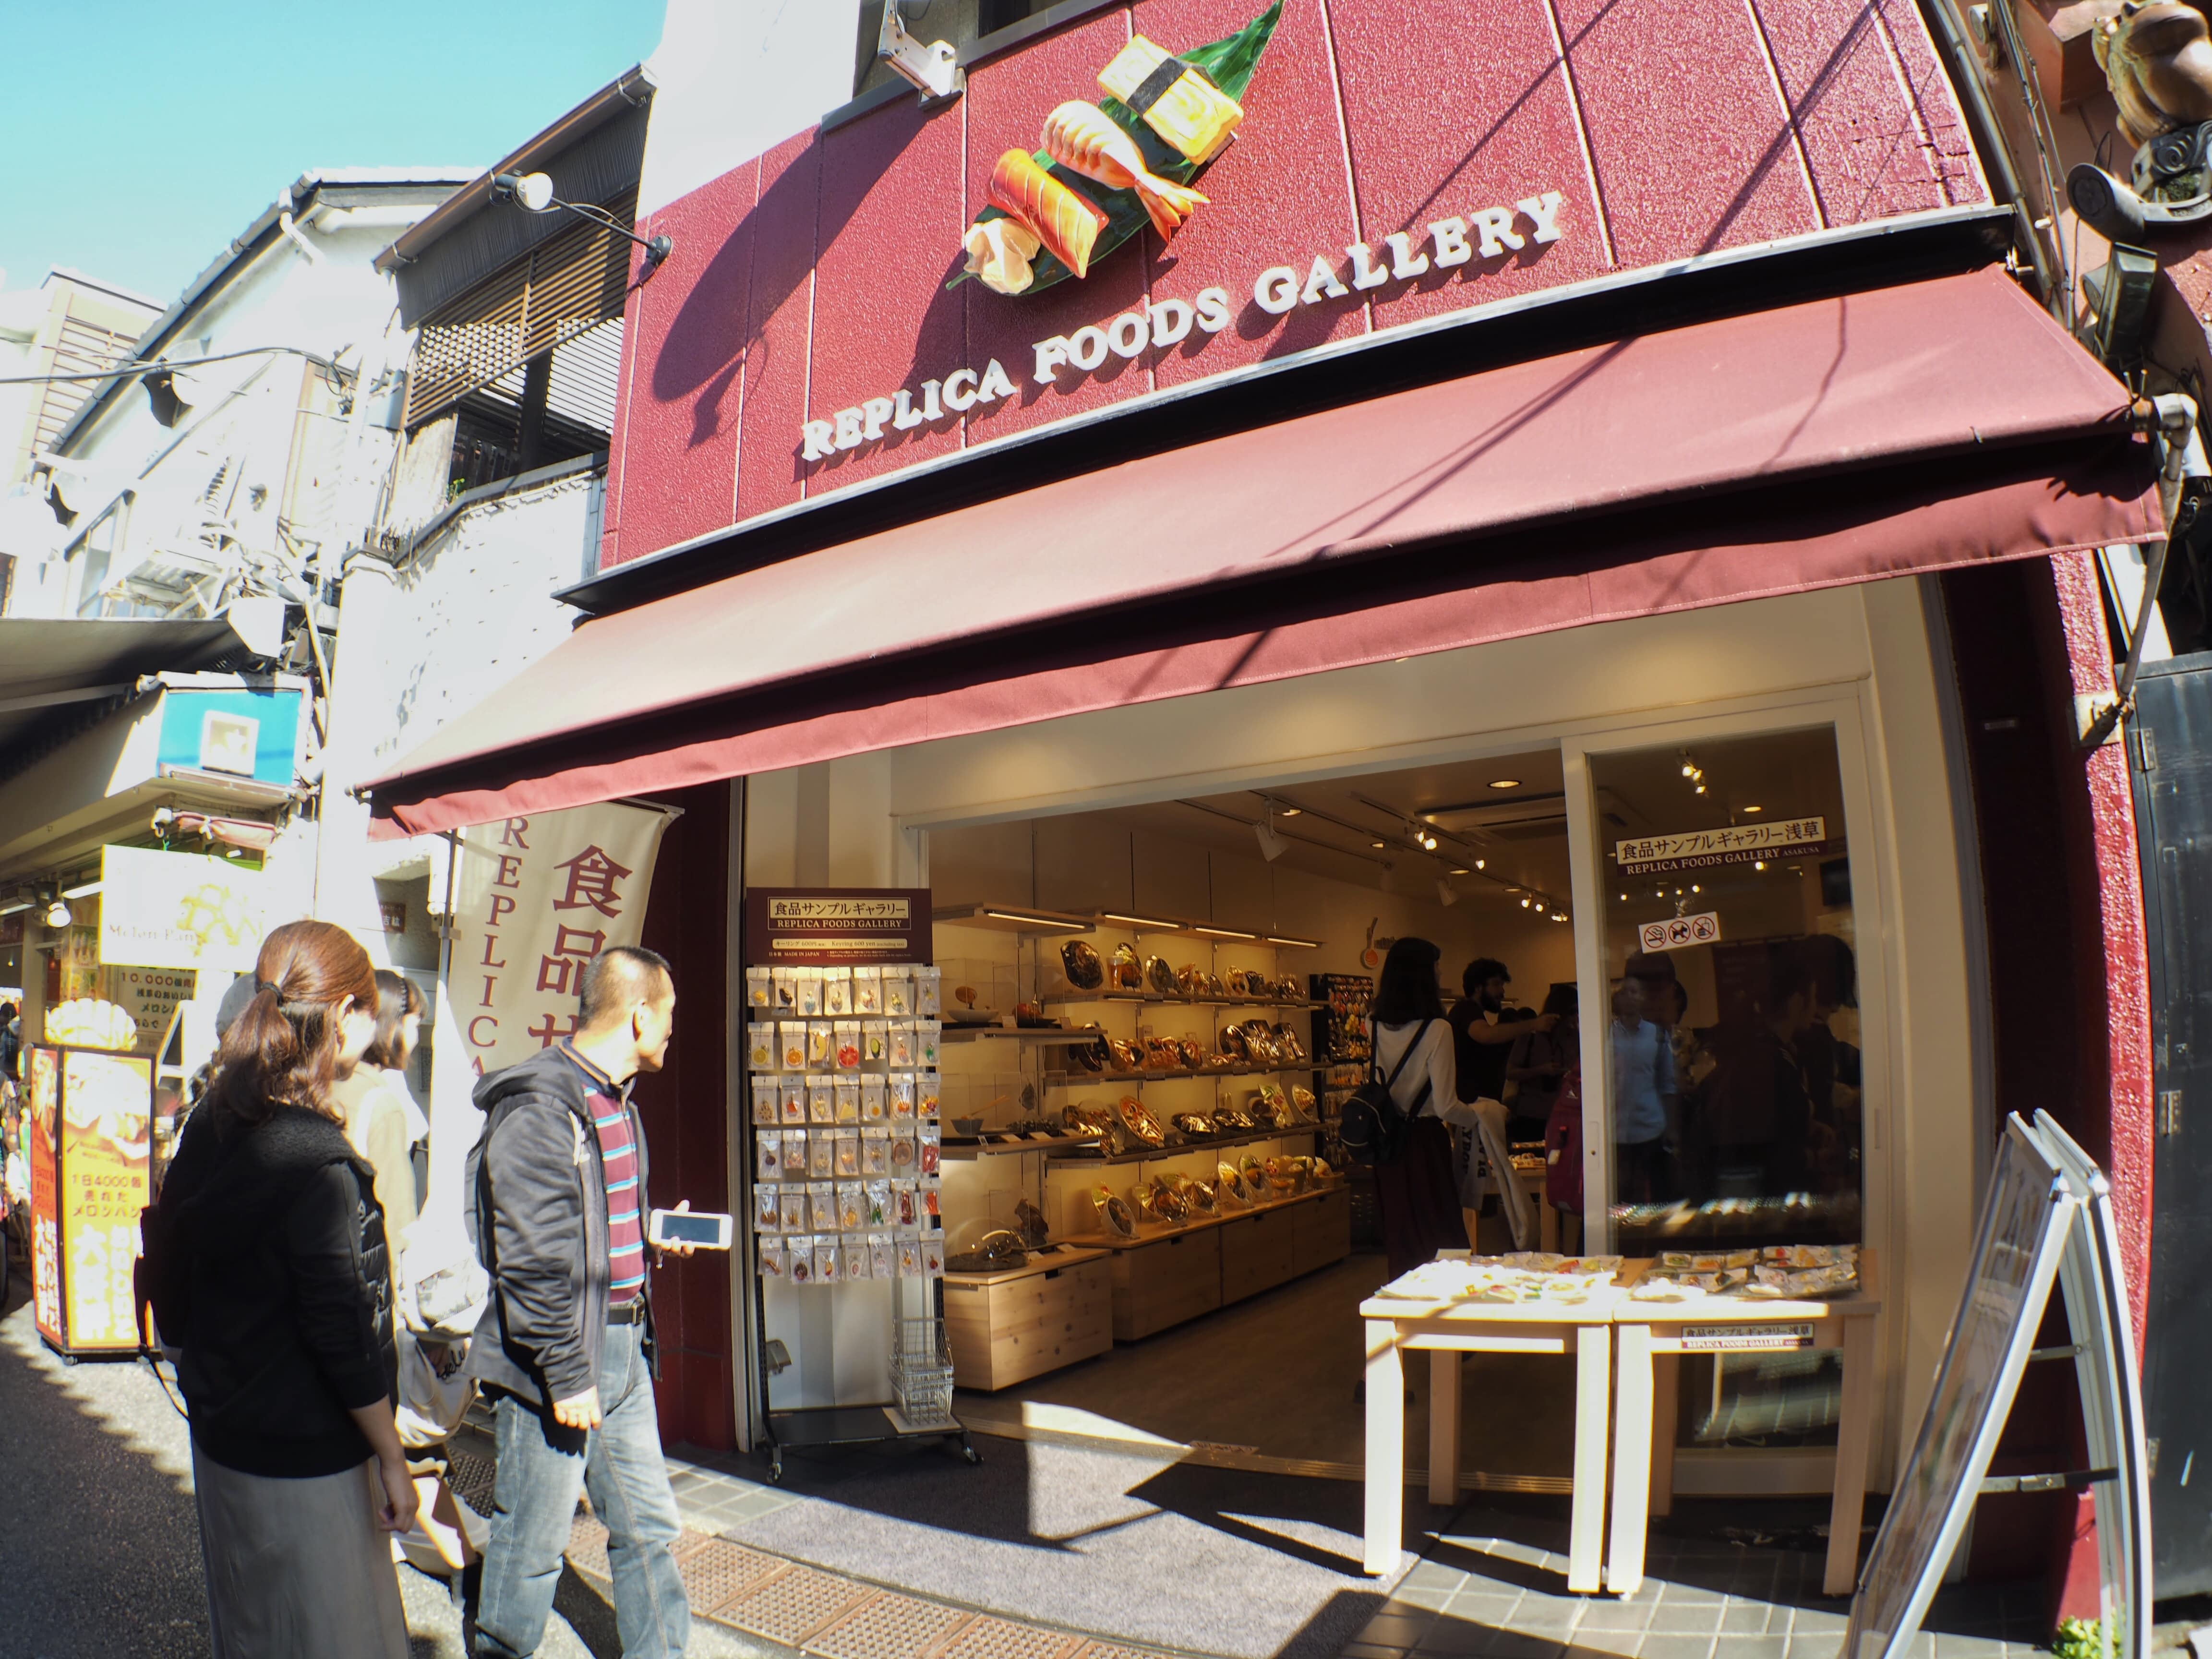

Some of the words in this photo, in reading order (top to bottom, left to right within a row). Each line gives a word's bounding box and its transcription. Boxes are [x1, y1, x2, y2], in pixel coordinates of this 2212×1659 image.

[801, 358, 1018, 462] REPLICA
[1032, 287, 1230, 384] FOODS
[1254, 191, 1563, 314] GALLERY
[1627, 861, 1678, 875] REPLICA
[1682, 854, 1722, 869] FOODS
[1725, 848, 1780, 863] GALLERY
[1783, 847, 1820, 857] ASAKUSA
[775, 902, 906, 916] 食品サンプルギャラリー
[778, 920, 820, 928] REPLICA
[823, 920, 855, 928] FOODS
[858, 920, 902, 928] GALLERY
